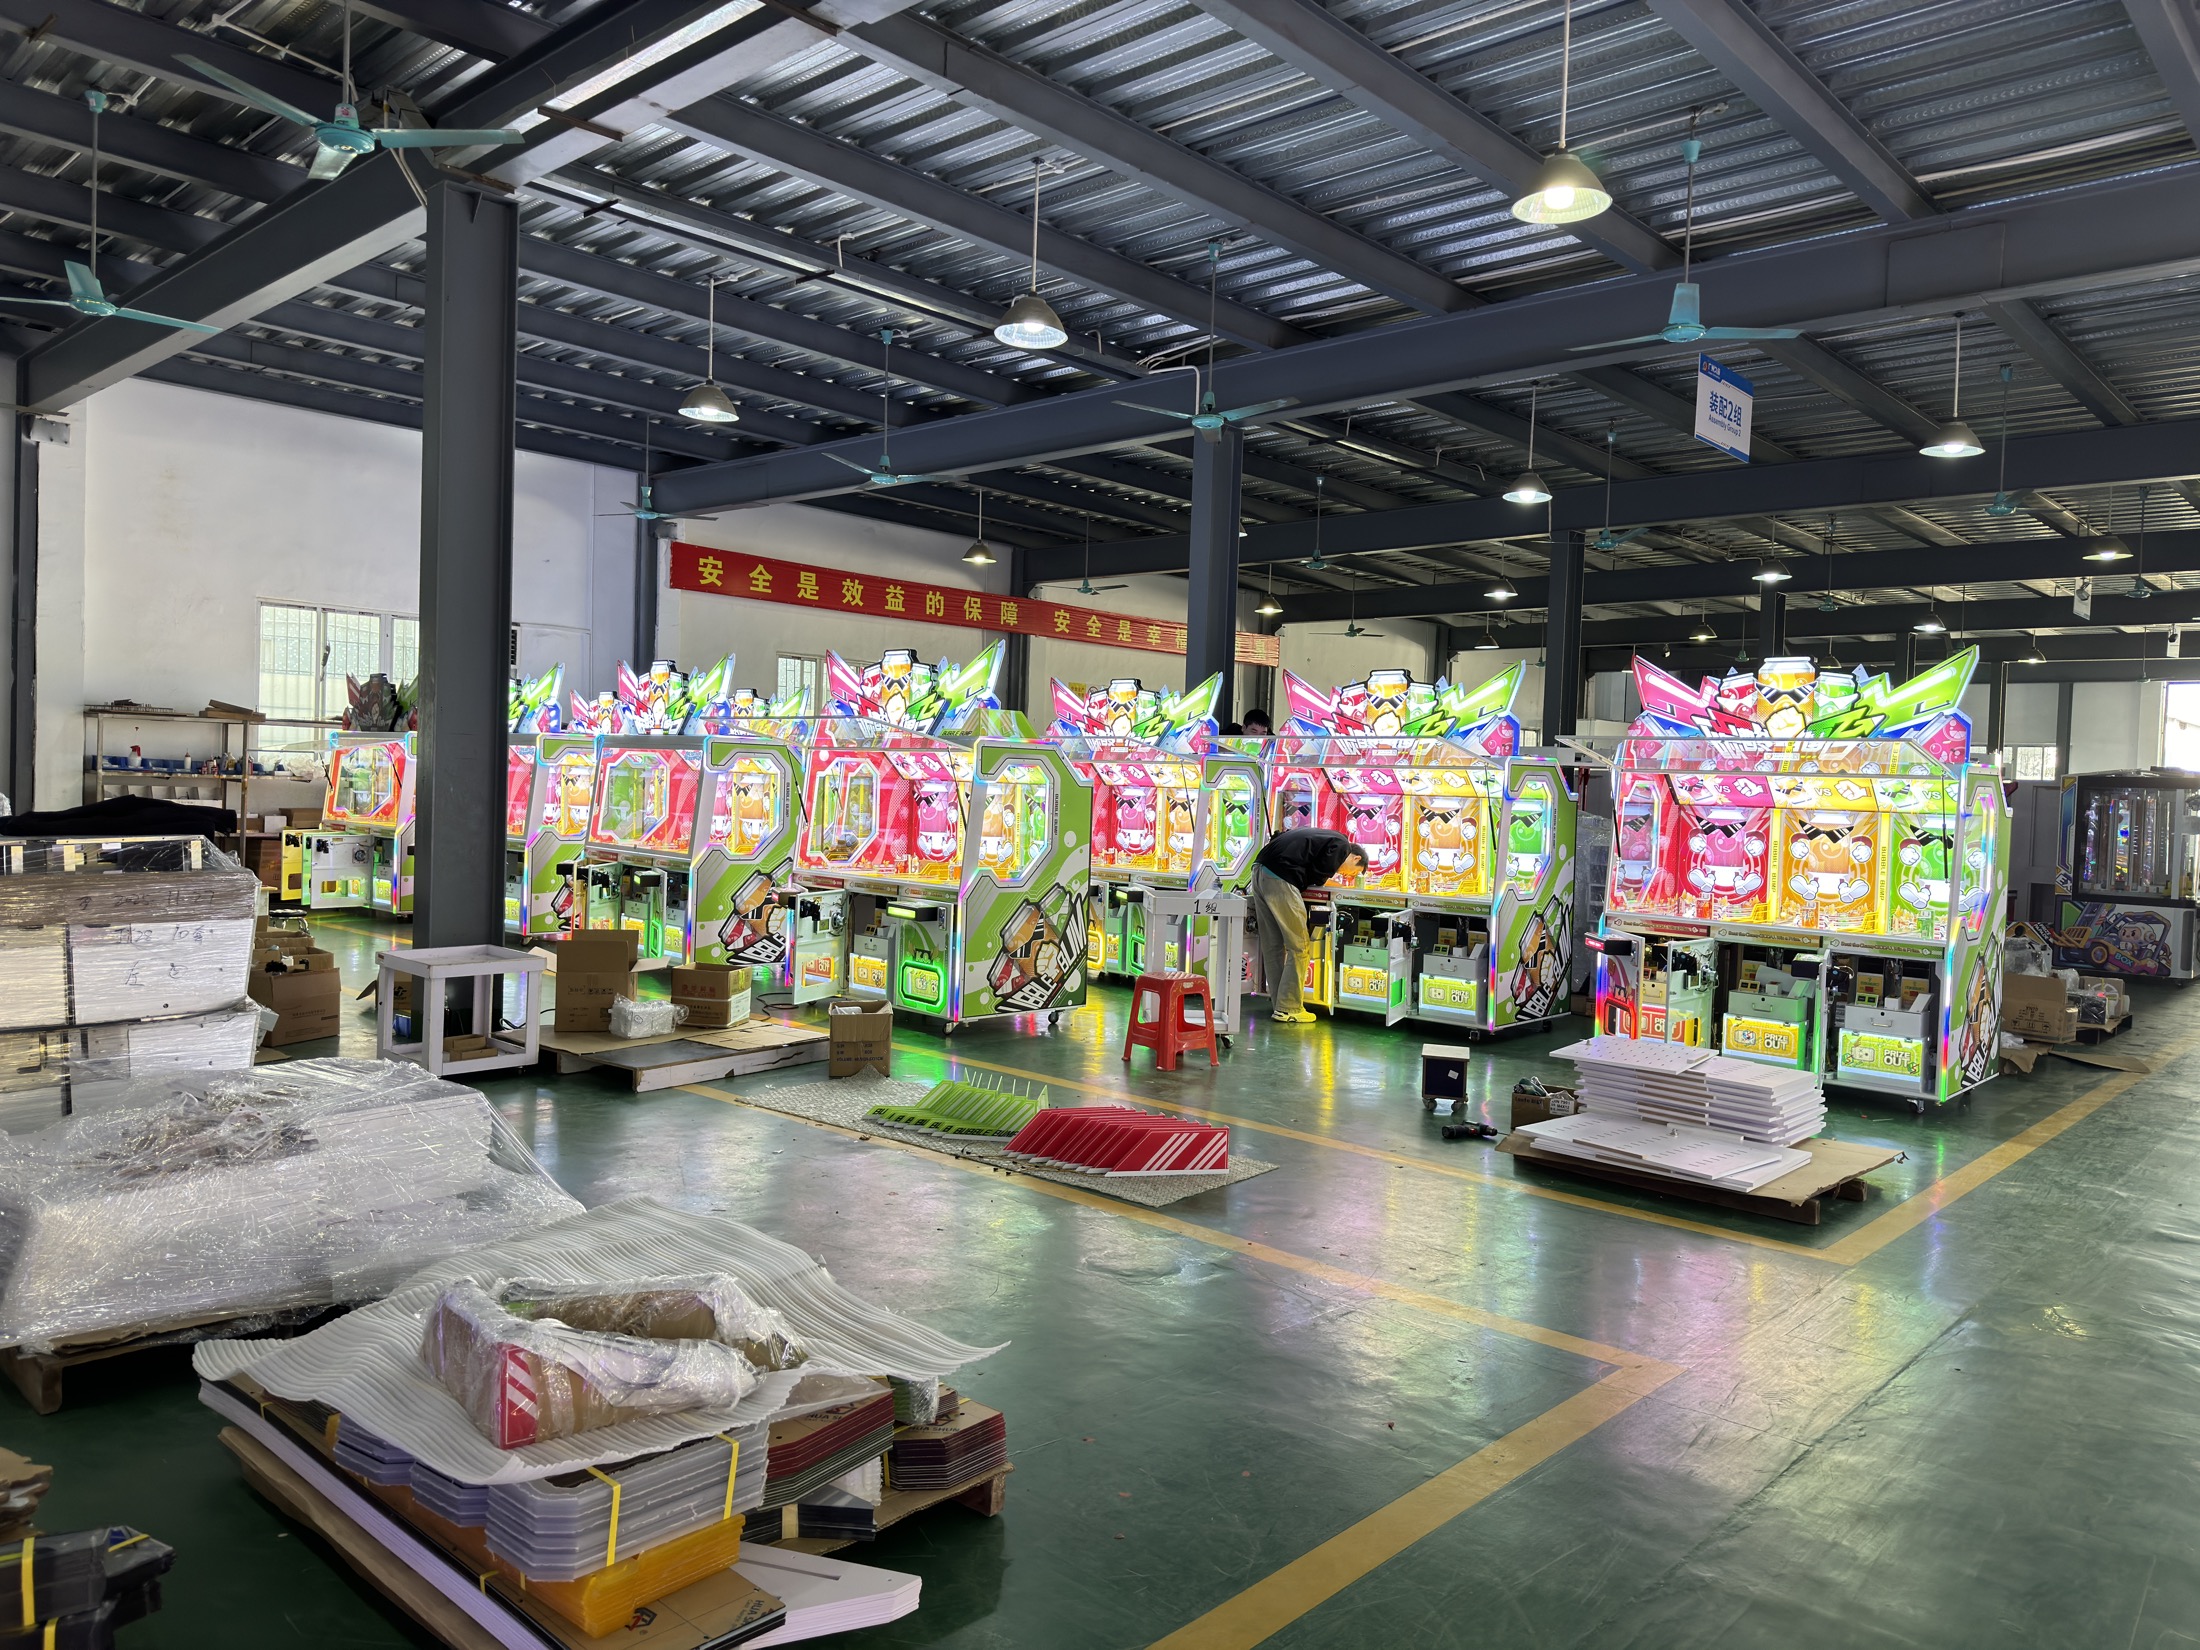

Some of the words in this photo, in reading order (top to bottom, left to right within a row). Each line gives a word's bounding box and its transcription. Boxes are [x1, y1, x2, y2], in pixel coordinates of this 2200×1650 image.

[1709, 391, 1742, 427] 装配2组
[1708, 414, 1727, 431] Assembly
[698, 556, 1018, 626] 安全是效益的保障
[1815, 787, 1833, 797] VS
[1921, 790, 1941, 800] VS
[2115, 952, 2133, 967] BOX
[1369, 983, 1386, 992] OUT
[1451, 989, 1470, 997] PRIZE
[1451, 994, 1470, 1004] OUT
[1764, 1033, 1788, 1043] PRIZE
[1764, 1038, 1788, 1050] OUT
[1884, 1049, 1911, 1059] PRIZE
[1883, 1056, 1909, 1068] OUT
